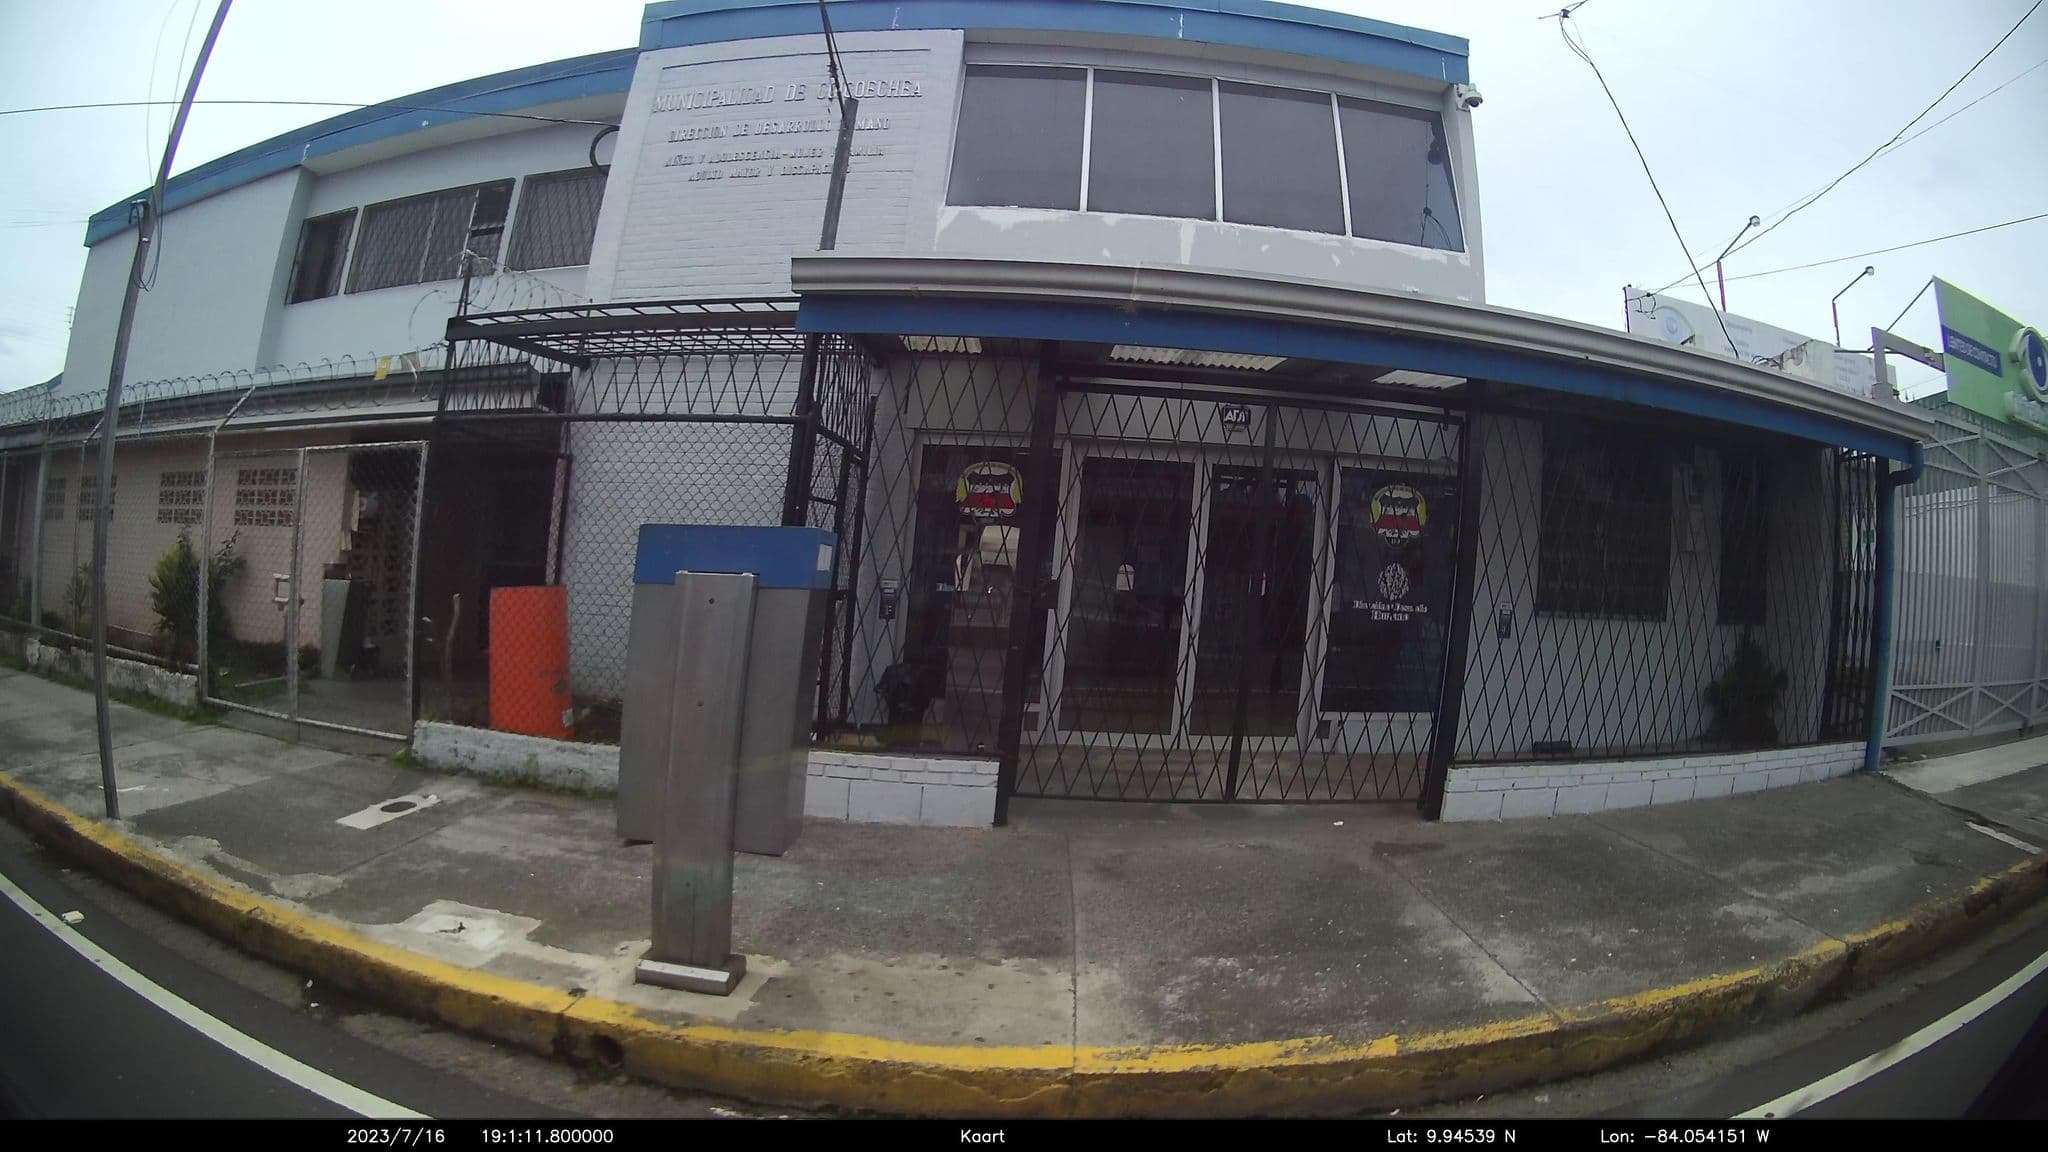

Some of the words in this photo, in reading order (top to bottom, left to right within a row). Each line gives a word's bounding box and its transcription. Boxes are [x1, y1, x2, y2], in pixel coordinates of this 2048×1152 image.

[652, 84, 775, 113] MUNICIPALIDAD
[784, 83, 806, 102] DE
[733, 122, 750, 137] DE
[854, 116, 889, 132] MANO
